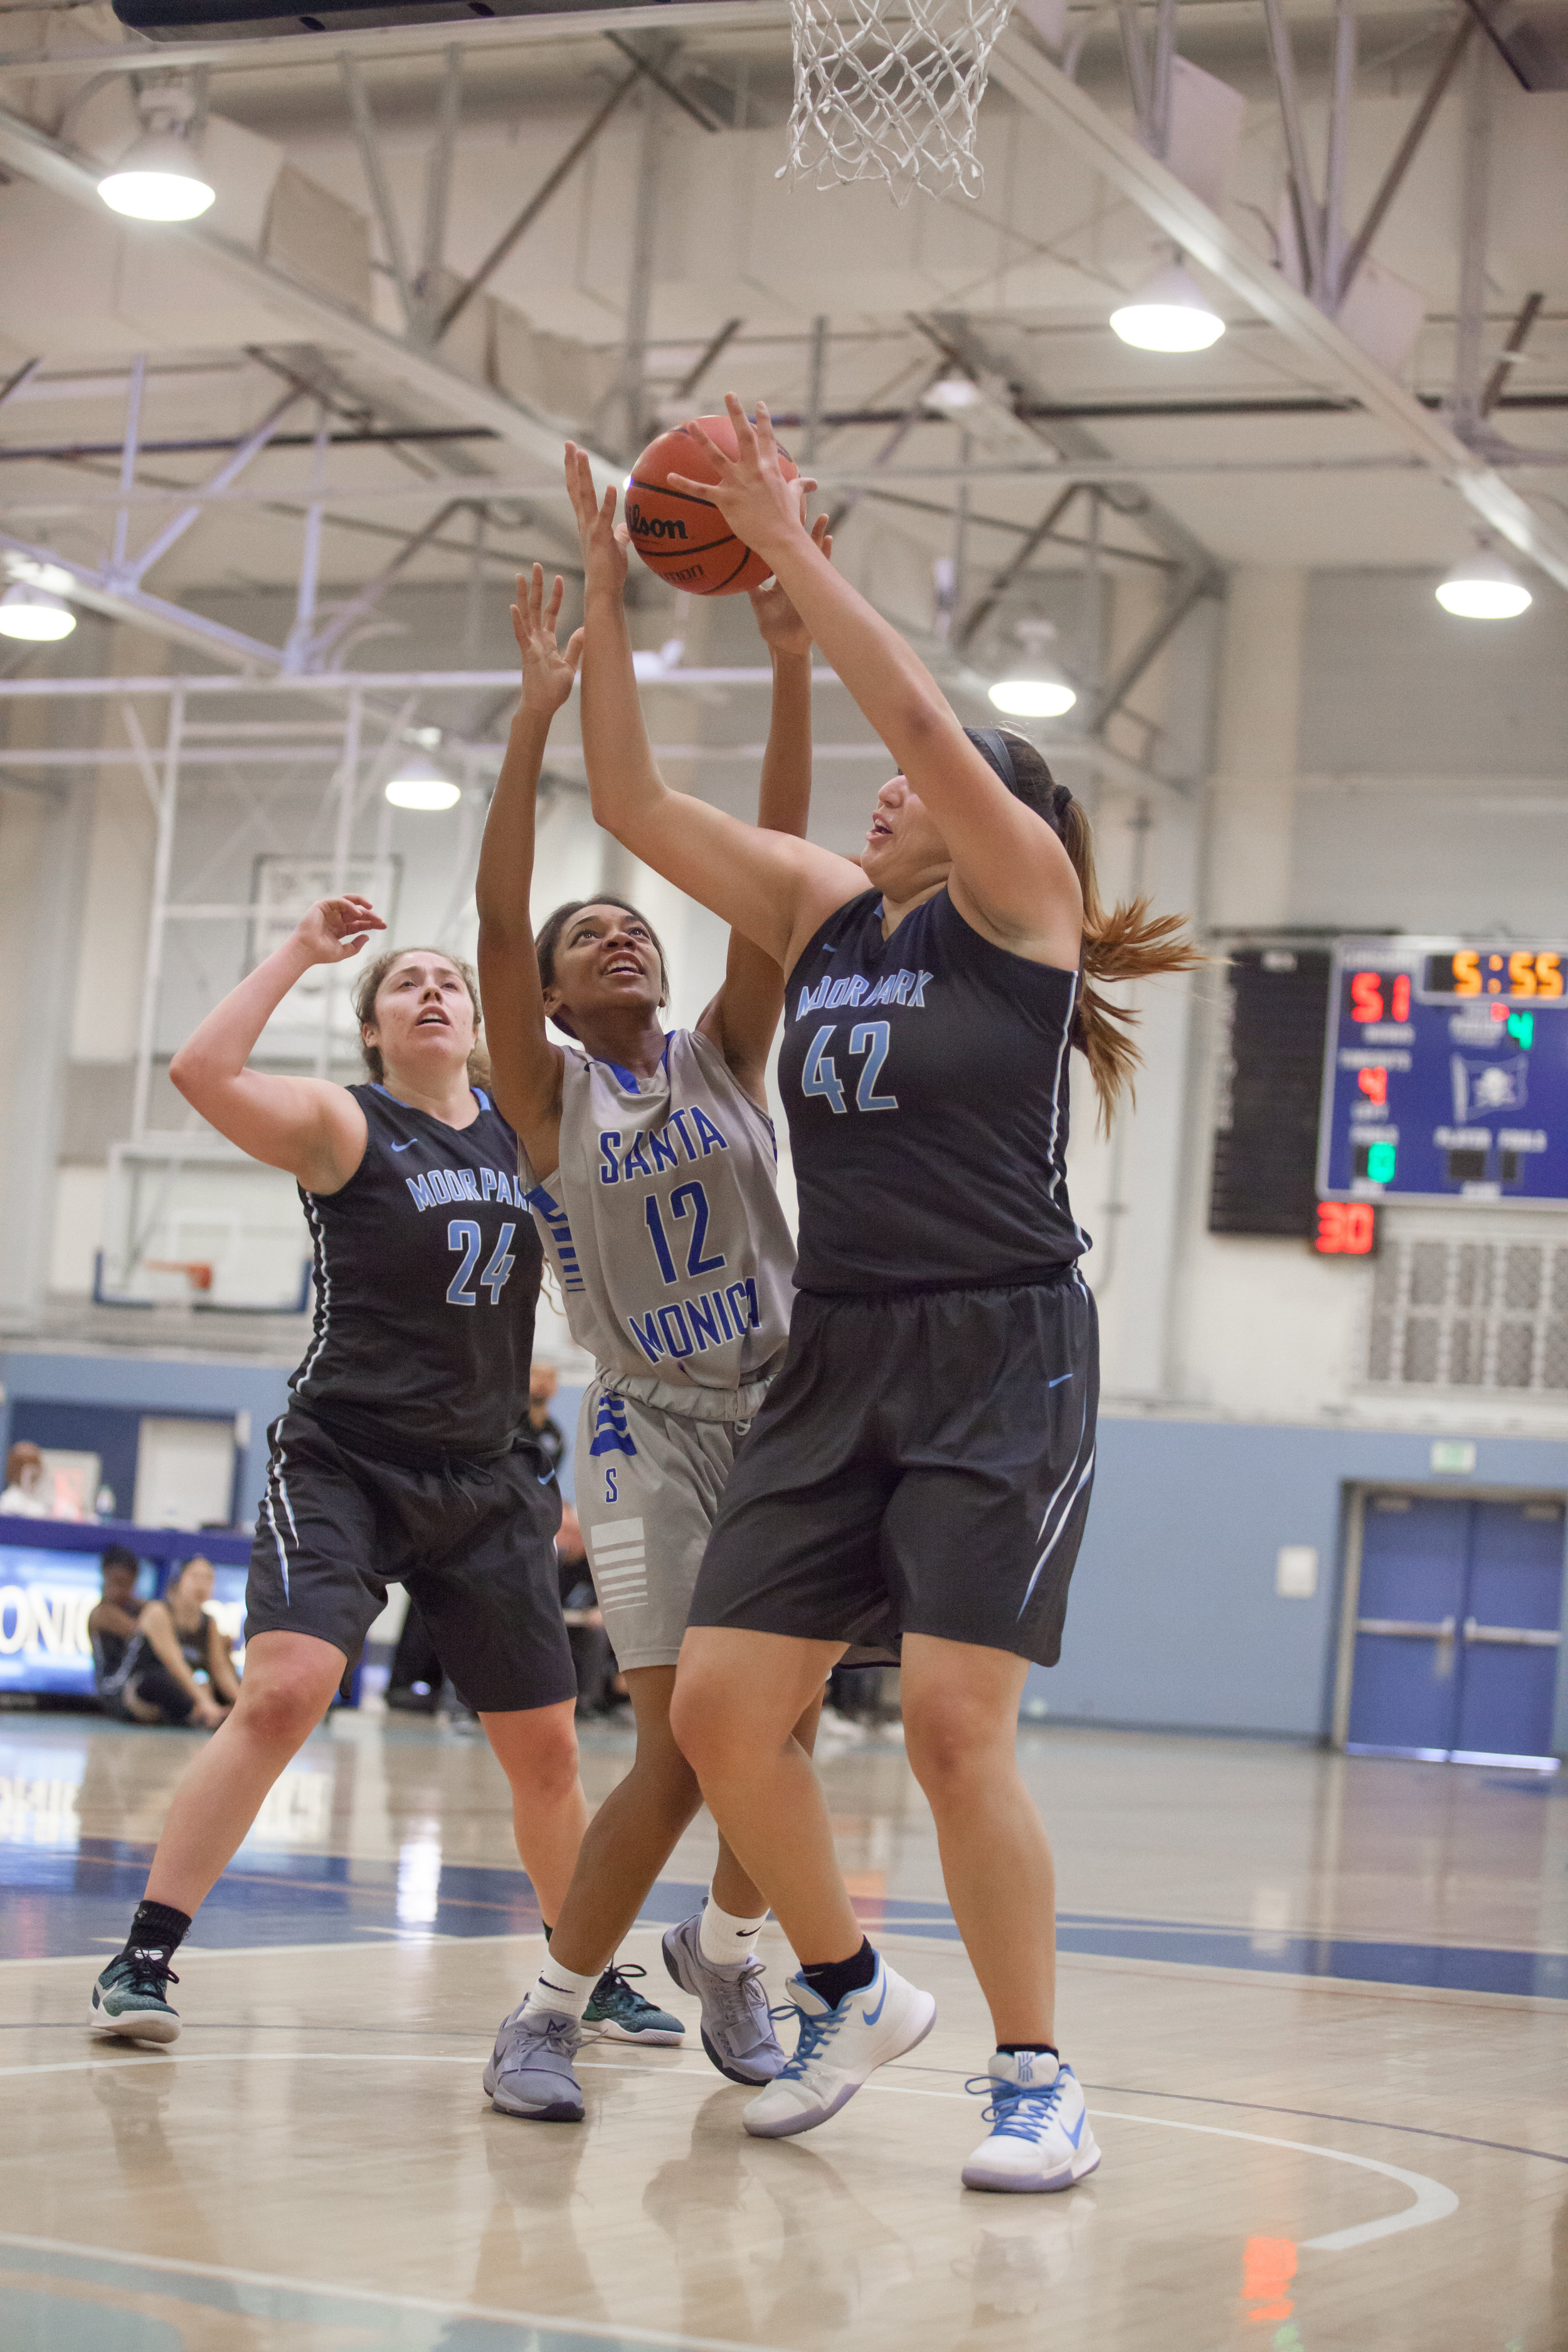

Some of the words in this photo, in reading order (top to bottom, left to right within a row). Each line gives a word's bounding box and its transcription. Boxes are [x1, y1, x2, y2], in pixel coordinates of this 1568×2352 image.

[1350, 972, 1411, 1022] 51
[1452, 950, 1564, 1000] 5:55
[802, 1020, 899, 1114] 42
[598, 1104, 729, 1185] SANTA
[406, 1167, 533, 1215] MOORPAR
[644, 1180, 728, 1286] 12
[1315, 1202, 1374, 1254] 30
[447, 1219, 516, 1306] 24
[628, 1275, 762, 1366] MONICA
[605, 1466, 618, 1504] S
